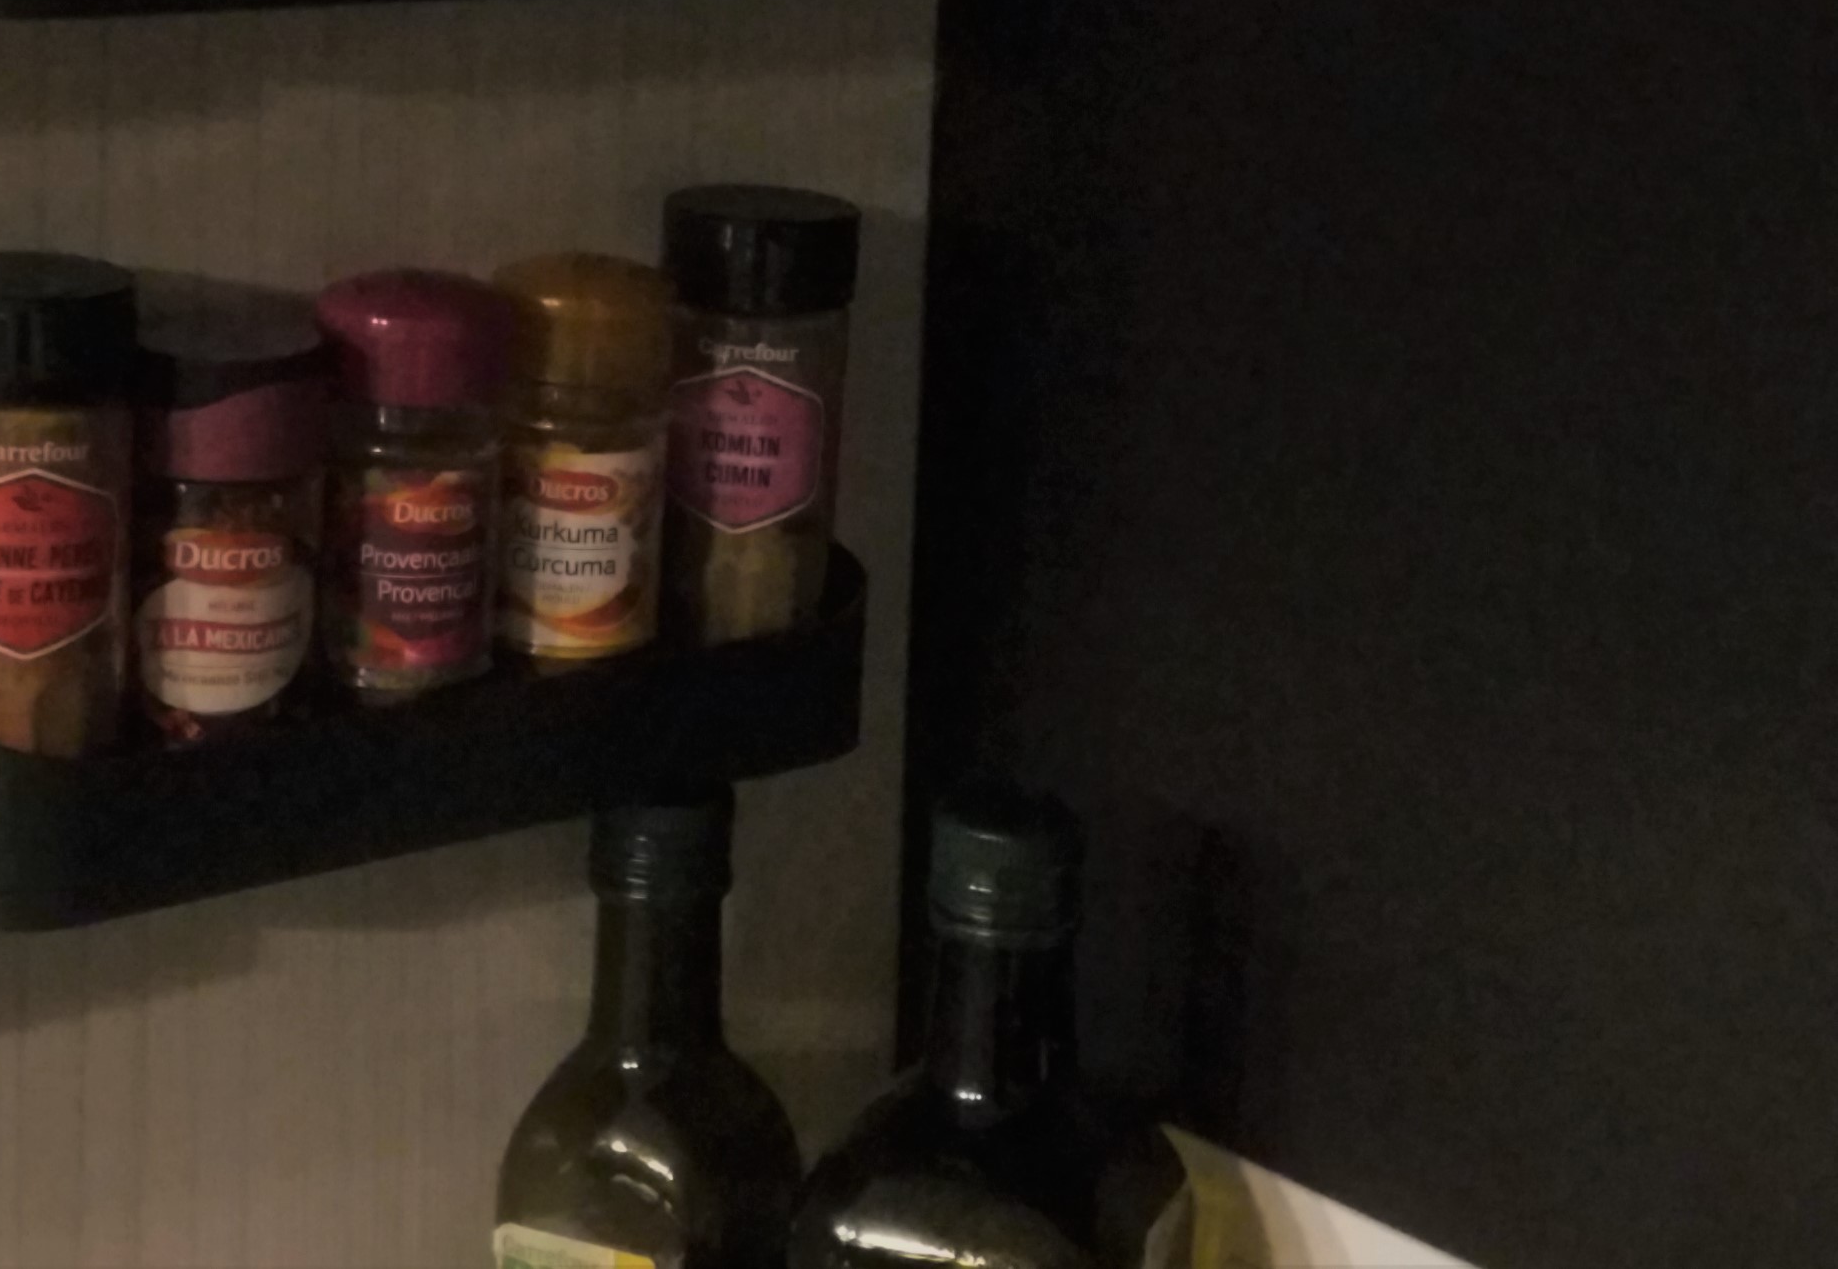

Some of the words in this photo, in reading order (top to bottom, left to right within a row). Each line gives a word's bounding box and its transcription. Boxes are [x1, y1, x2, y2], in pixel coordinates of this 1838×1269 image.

[702, 429, 781, 457] KOMIJN
[705, 462, 772, 488] CUMIN
[394, 502, 474, 524] Ducros
[514, 515, 618, 544] Kurkuma
[175, 541, 283, 570] Ducros
[513, 547, 616, 576] Curcuma
[30, 577, 108, 605] CAYE
[174, 627, 198, 648] LA
[205, 624, 296, 651] MEXICAI
